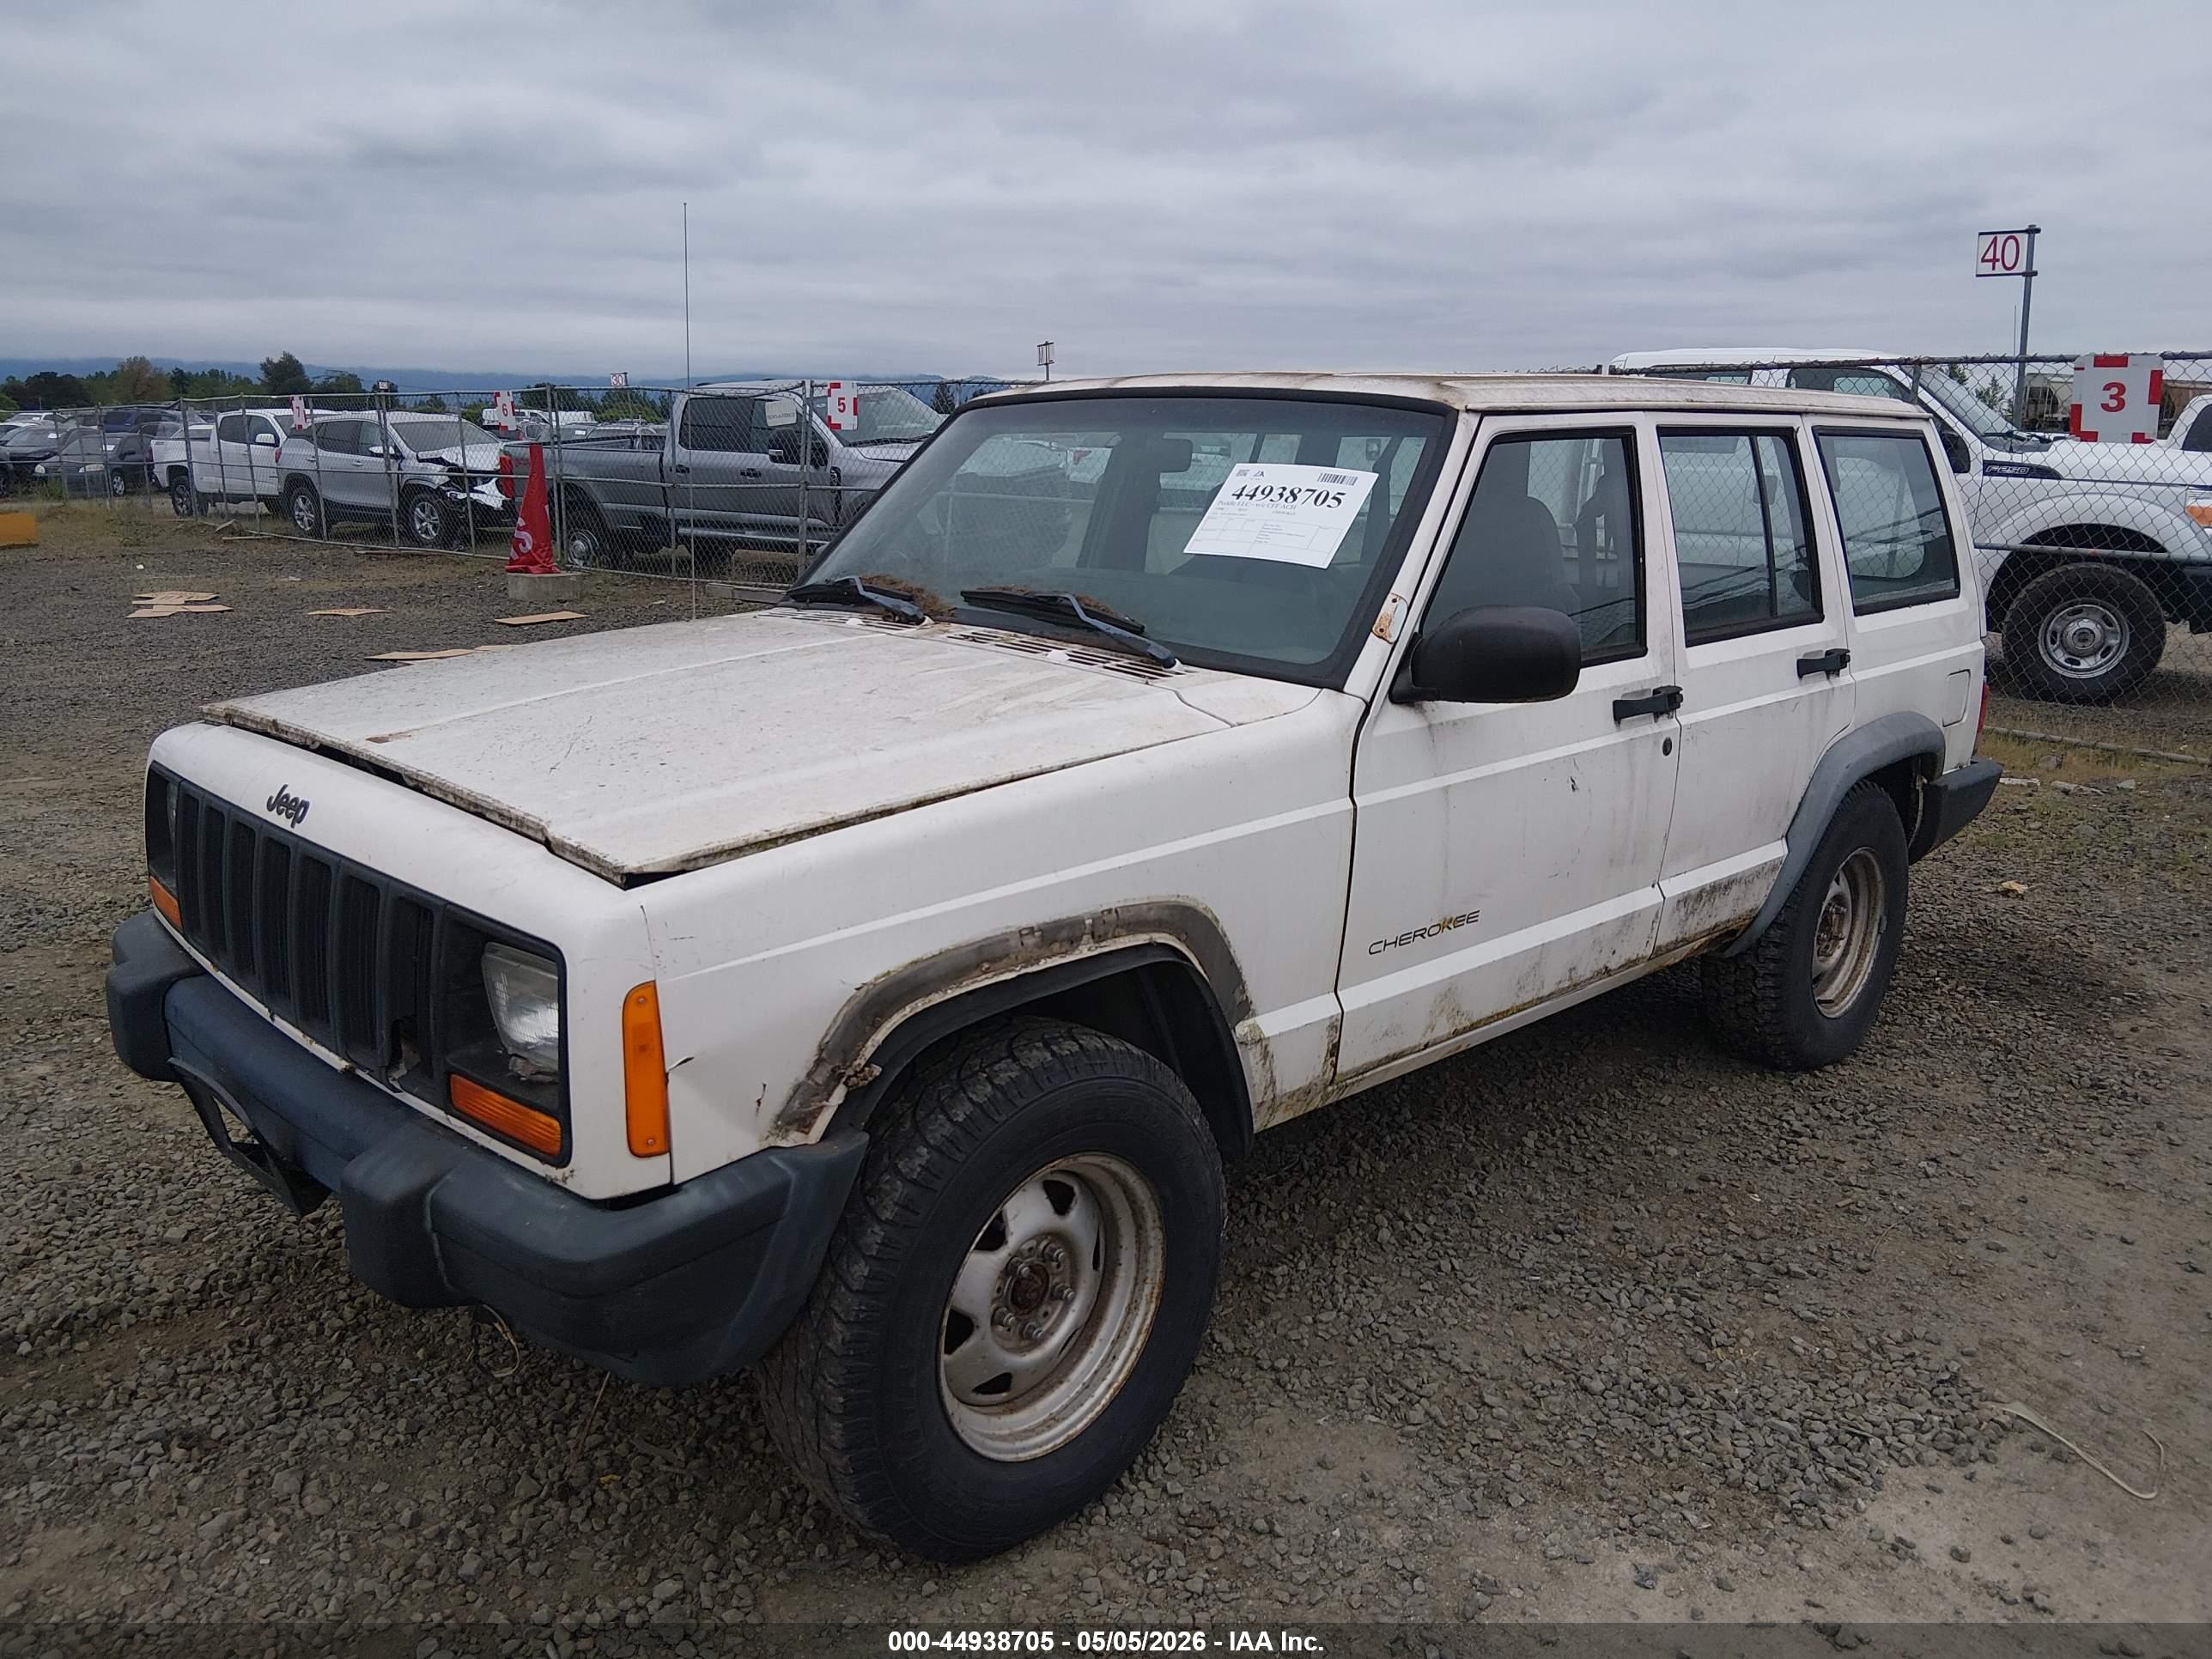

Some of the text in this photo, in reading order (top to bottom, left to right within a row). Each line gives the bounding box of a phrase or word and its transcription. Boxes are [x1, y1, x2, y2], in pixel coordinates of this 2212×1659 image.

[1980, 234, 2021, 271] 40
[611, 374, 623, 386] 30
[501, 403, 508, 417] 6
[837, 397, 847, 413] 5
[2100, 381, 2127, 413] 3
[1231, 483, 1347, 509] 44938705
[266, 783, 311, 829] Jeep
[1368, 909, 1481, 956] CHEROKEE
